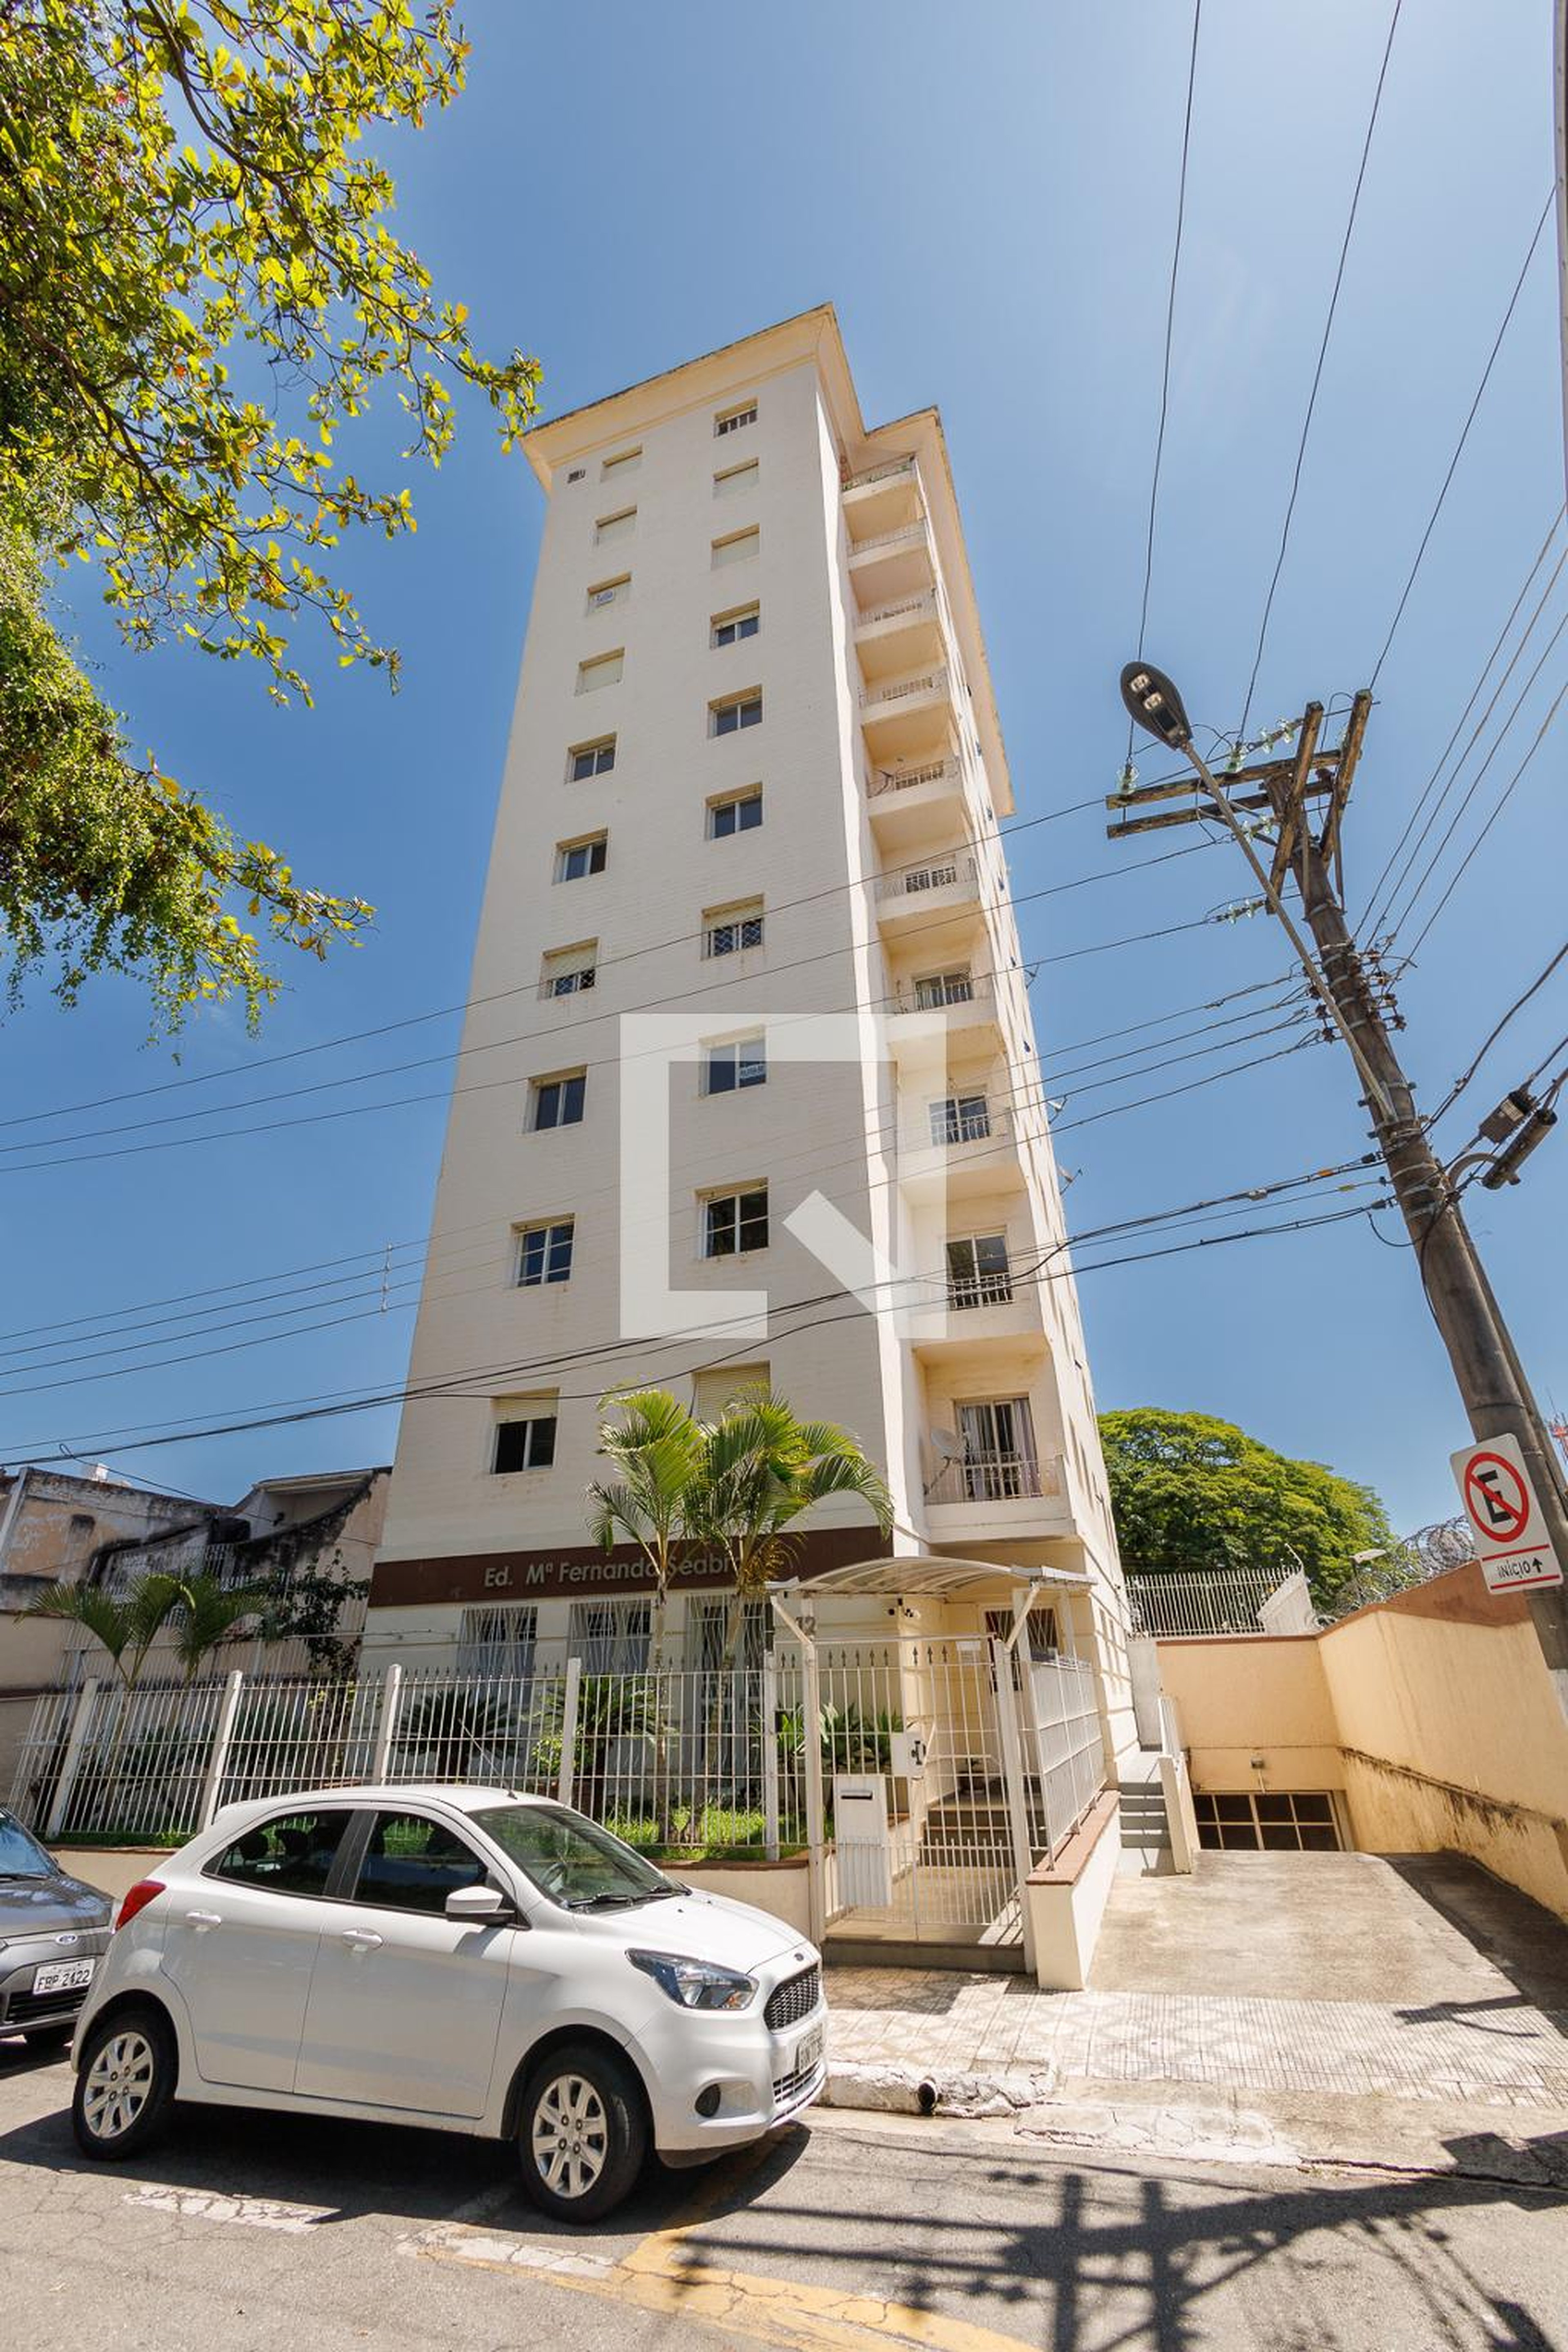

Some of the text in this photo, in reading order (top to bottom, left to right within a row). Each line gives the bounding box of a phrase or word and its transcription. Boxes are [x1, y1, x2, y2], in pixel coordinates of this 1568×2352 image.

[484, 1566, 513, 1588] Ed.
[667, 1553, 744, 1576] Seabr
[1497, 1559, 1531, 1579] INÍCIO
